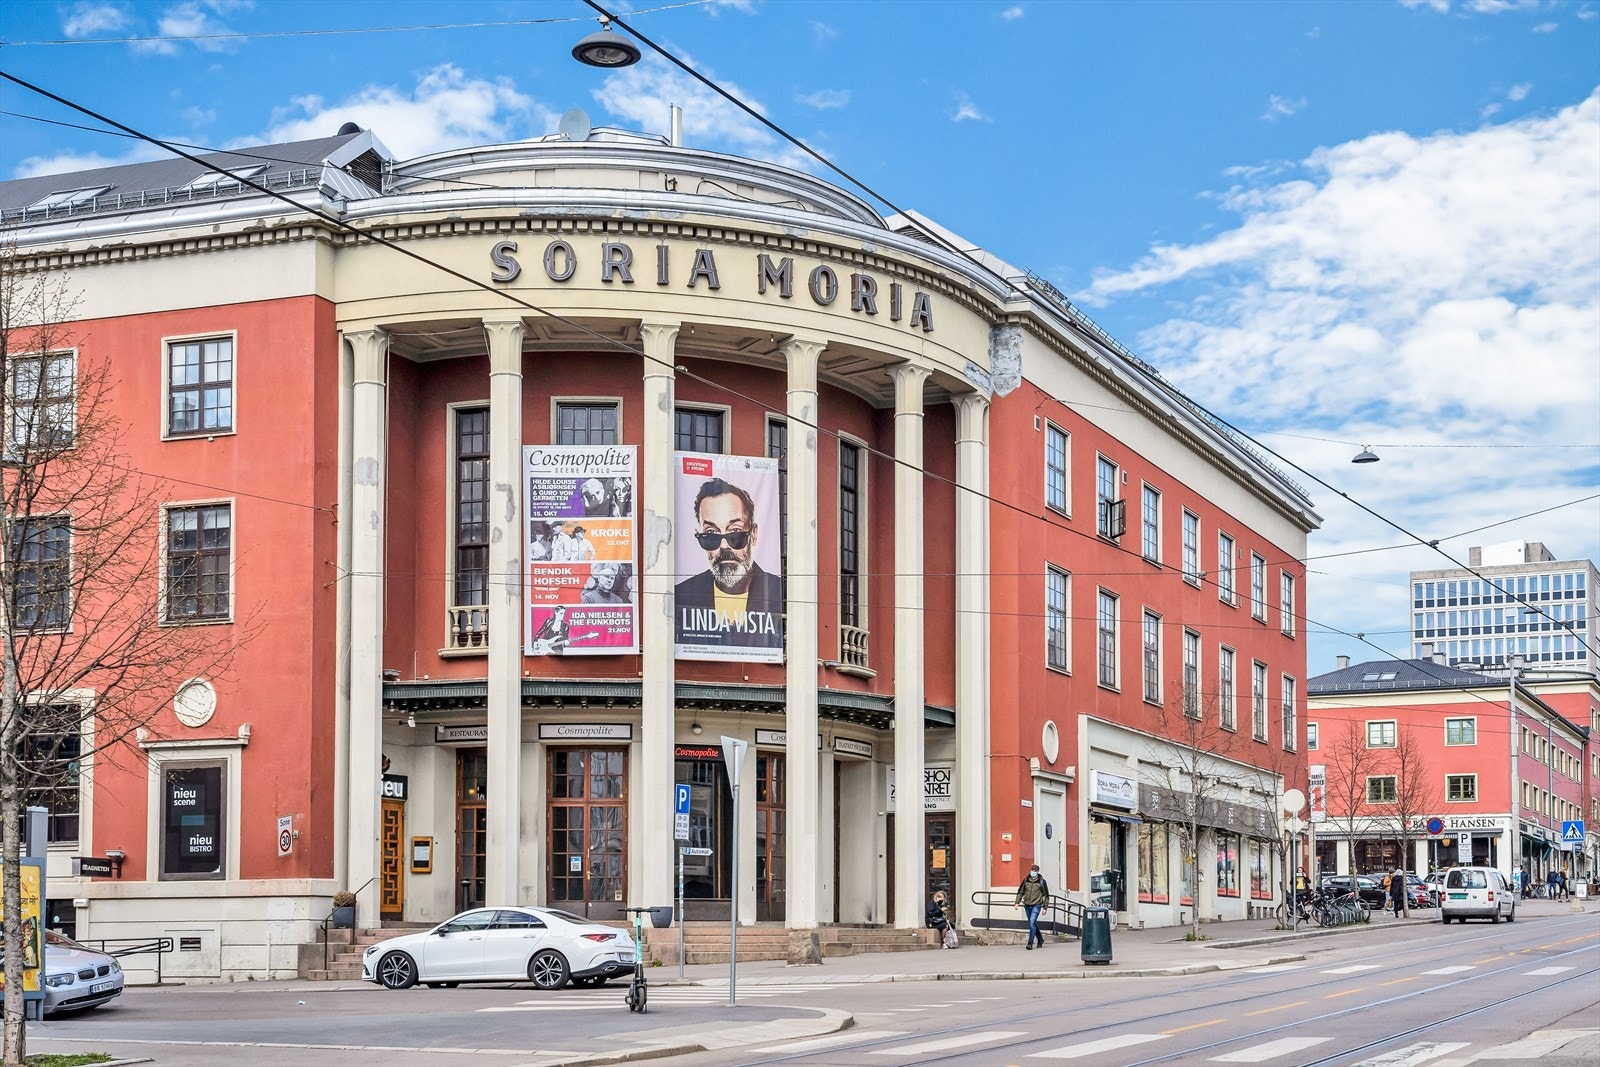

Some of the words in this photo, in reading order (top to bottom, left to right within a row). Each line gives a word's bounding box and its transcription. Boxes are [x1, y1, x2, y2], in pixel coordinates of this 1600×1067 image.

[490, 240, 721, 290] SORIA
[756, 253, 934, 333] MORIA
[530, 448, 630, 473] Cosmopolite
[591, 529, 629, 537] KROKE
[682, 608, 730, 633] LINDA
[734, 611, 775, 634] VISTA
[450, 730, 488, 738] RESTAURAN
[557, 726, 613, 736] Cosmopolite
[675, 748, 719, 760] Cosmopolite
[381, 774, 403, 797] ieu
[174, 788, 196, 798] nieu
[679, 789, 687, 810] P
[1450, 819, 1496, 828] HANSEN
[190, 834, 212, 845] nieu
[282, 834, 290, 847] 30
[1461, 834, 1468, 843] P
